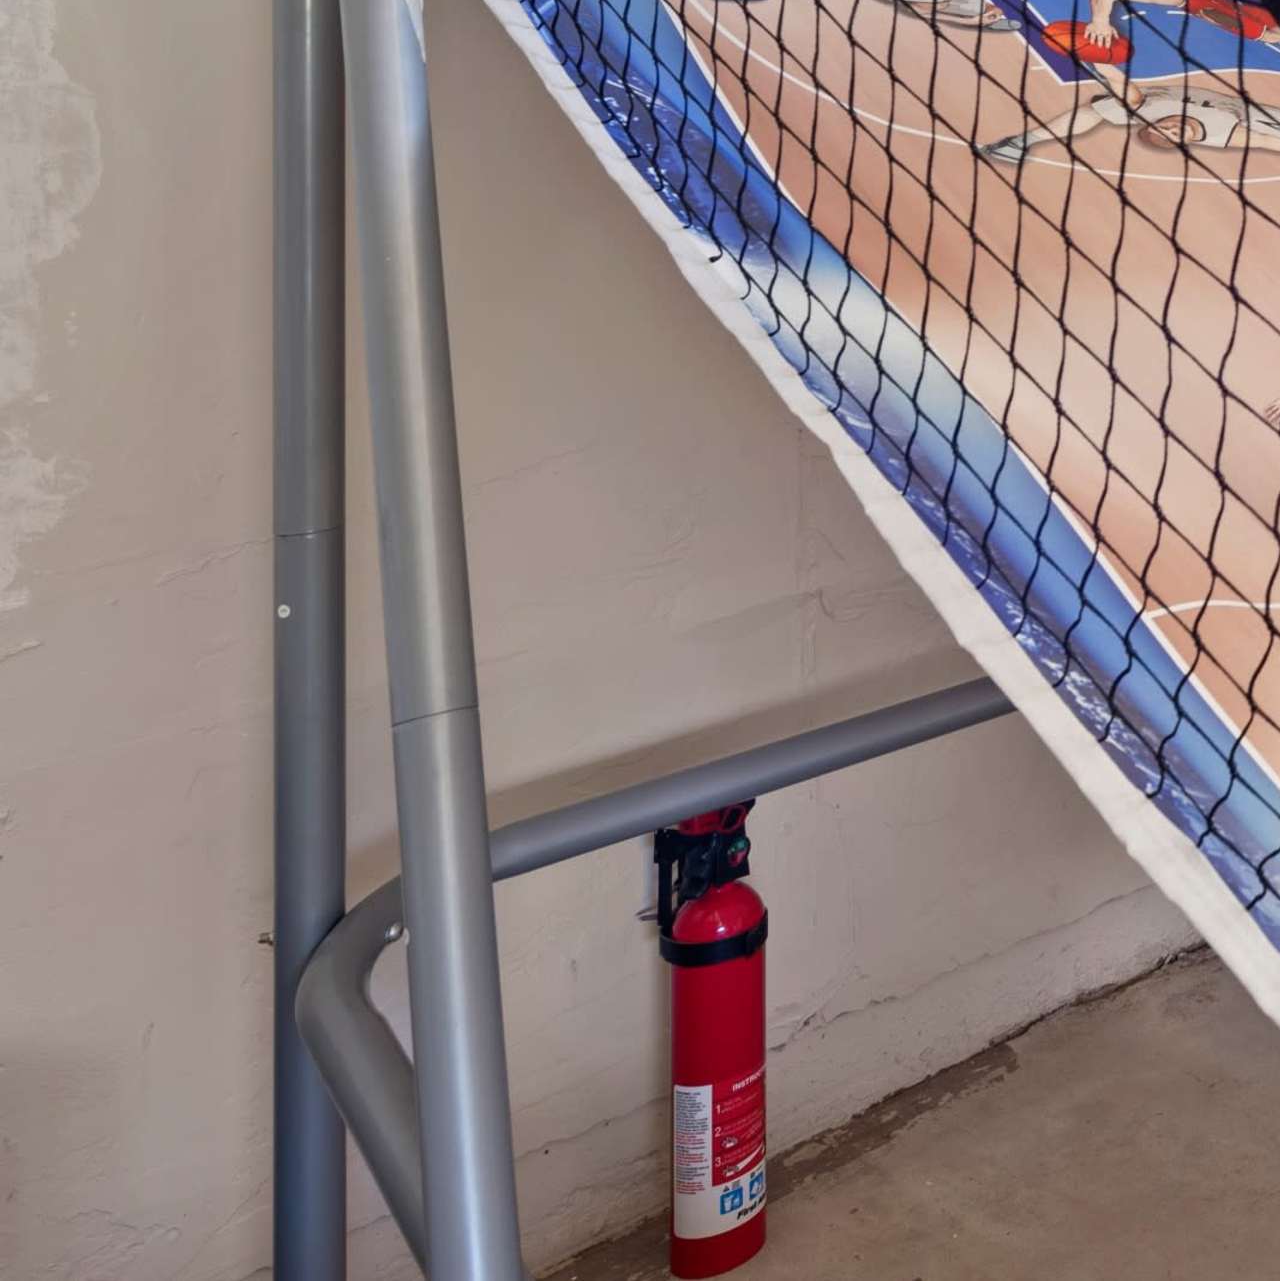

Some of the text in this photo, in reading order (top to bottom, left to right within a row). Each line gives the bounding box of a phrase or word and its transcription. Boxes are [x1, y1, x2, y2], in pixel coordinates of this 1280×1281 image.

[715, 1103, 721, 1115] 1
[714, 1127, 722, 1138] 2
[714, 1156, 722, 1167] 3
